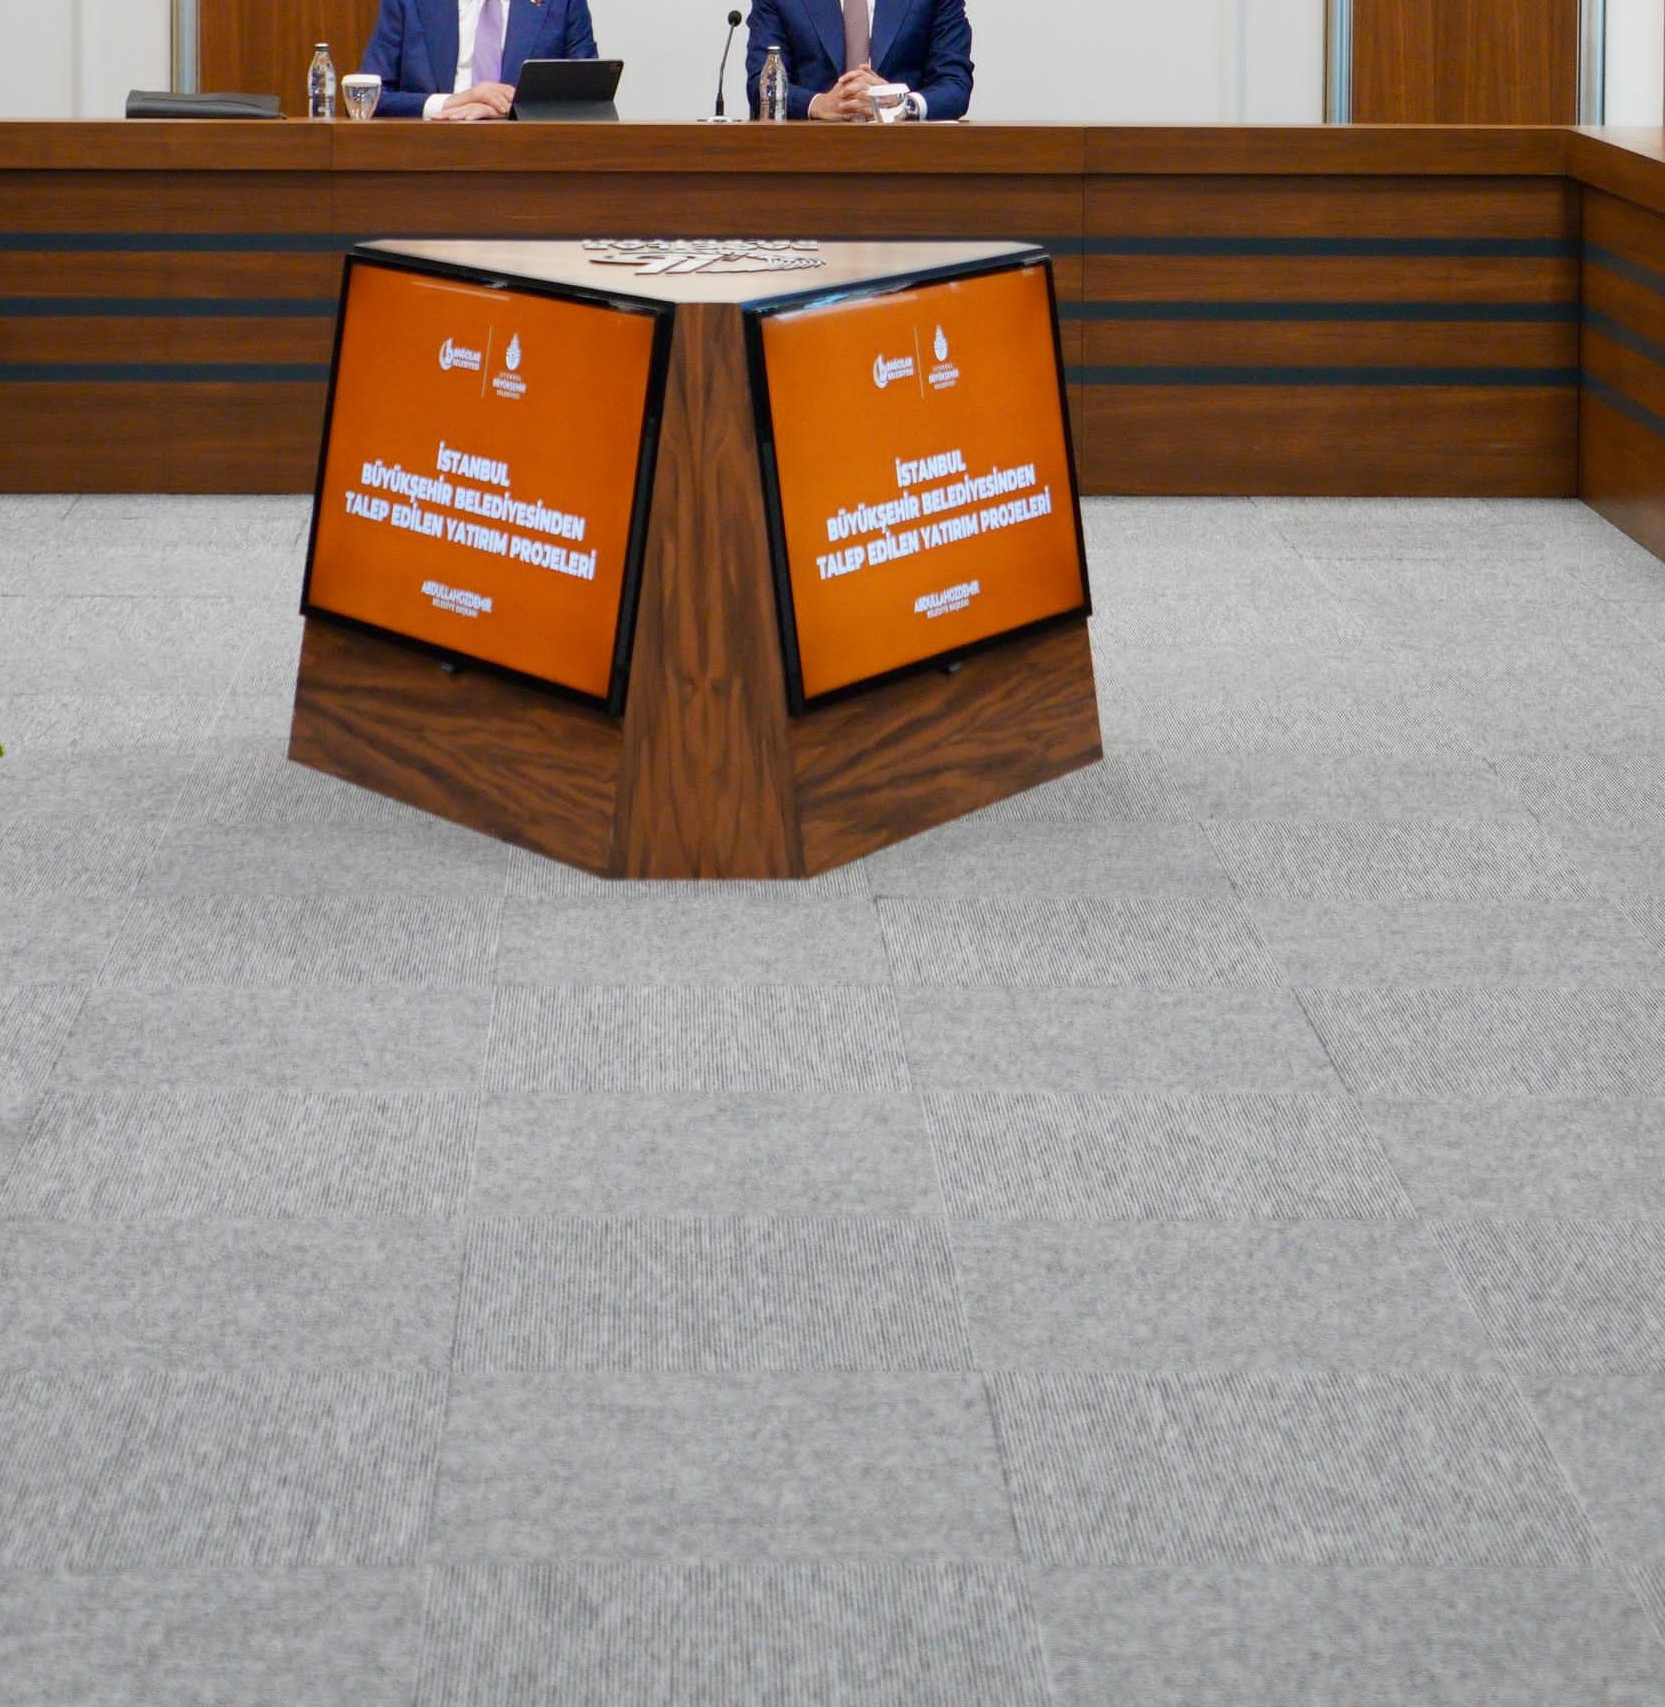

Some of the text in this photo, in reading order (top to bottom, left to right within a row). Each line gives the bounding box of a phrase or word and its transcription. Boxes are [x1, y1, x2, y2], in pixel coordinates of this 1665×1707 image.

[361, 458, 586, 541] BÜYÜKŞEHİR BELEDİYESİNDEN
[436, 440, 510, 487] İSTANBUL
[826, 464, 1036, 541] BÜYÜKŞEHİR BELEDİYESİNDEN
[895, 449, 966, 487] İSTANBUL
[345, 490, 598, 581] TALEP EDİLEN YATIRIM PROJELERİ
[816, 485, 1052, 580] TALEP EDİLEN YATIRIM PROJELERİ
